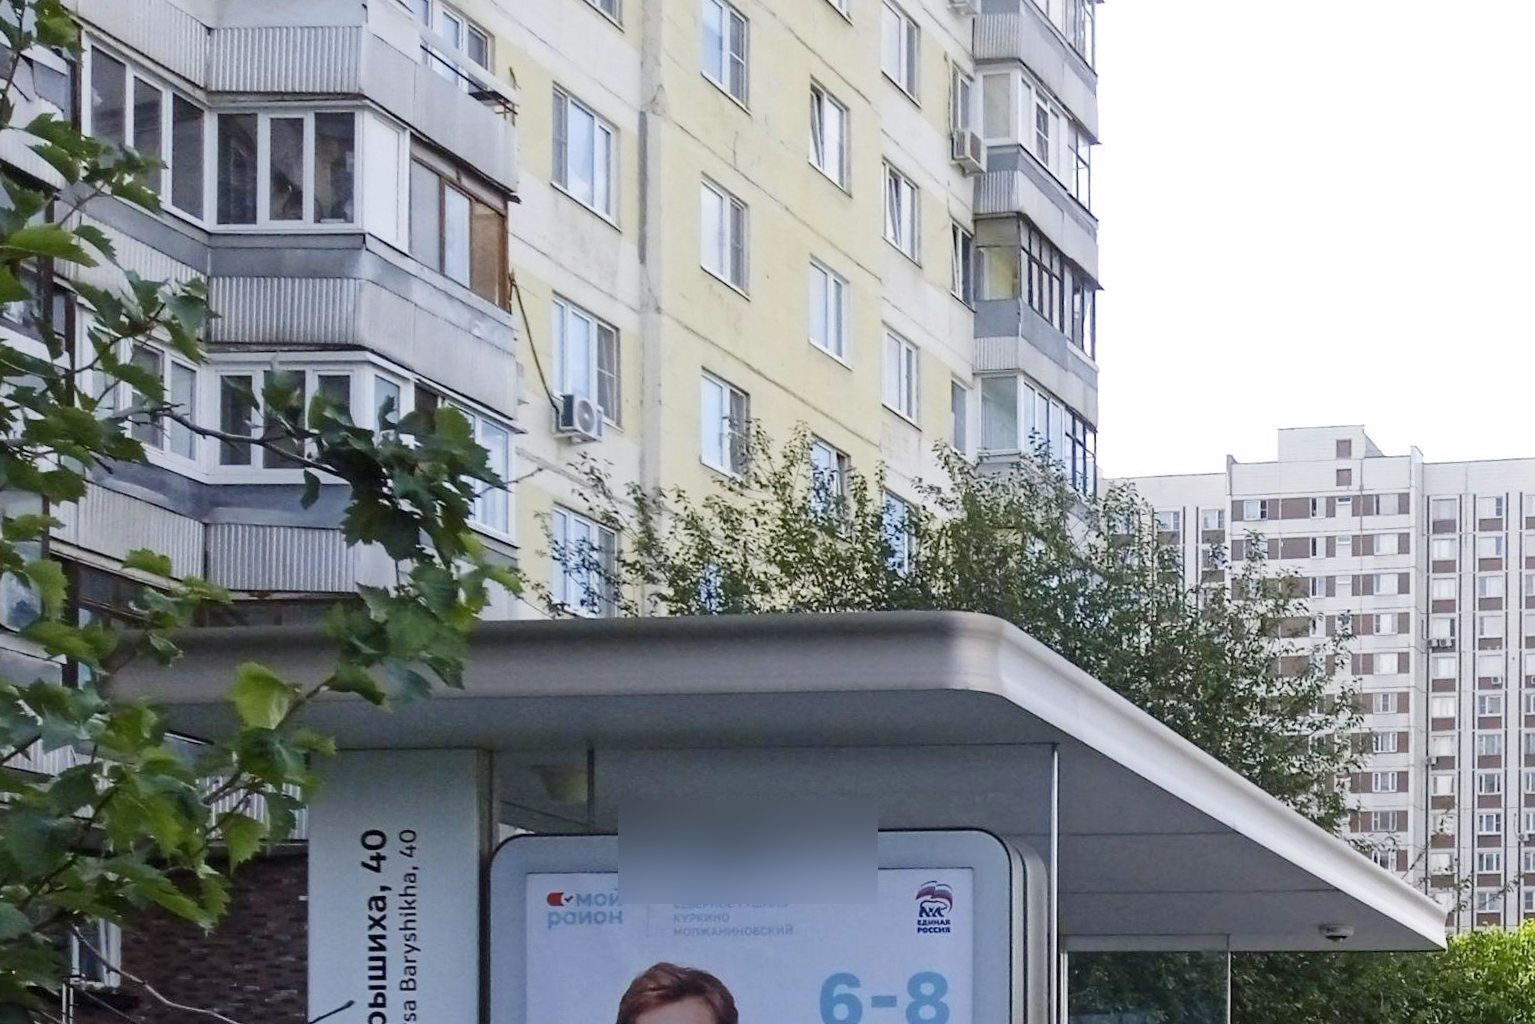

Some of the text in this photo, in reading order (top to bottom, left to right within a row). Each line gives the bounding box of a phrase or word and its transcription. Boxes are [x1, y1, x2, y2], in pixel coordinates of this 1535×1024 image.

[361, 829, 387, 873] 40
[399, 829, 417, 858] 40
[399, 865, 421, 991] Baryshikha,
[673, 913, 730, 923] КУРКИНО
[917, 926, 951, 934] РОССИЯ
